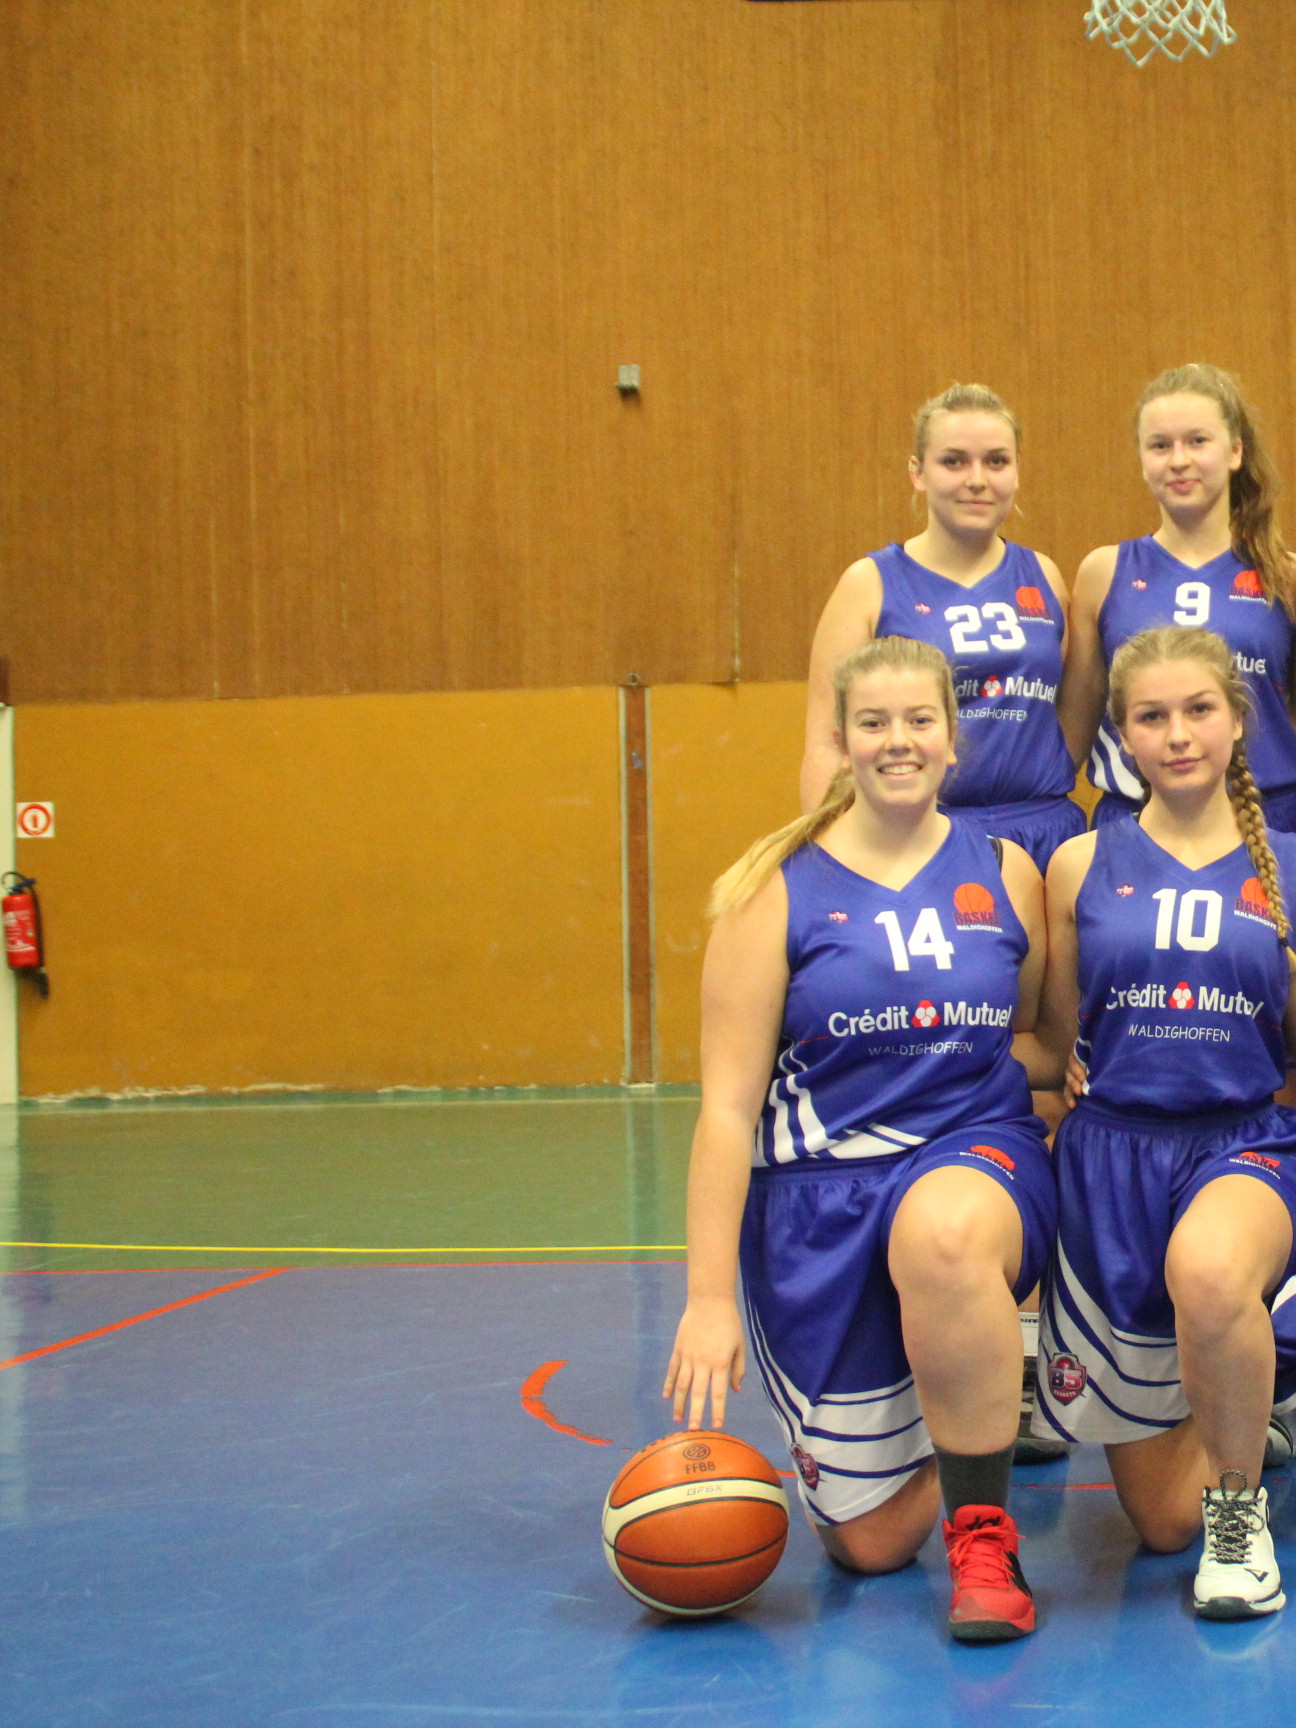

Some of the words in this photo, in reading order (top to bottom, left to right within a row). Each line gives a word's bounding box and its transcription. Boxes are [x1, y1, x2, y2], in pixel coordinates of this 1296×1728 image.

[1173, 581, 1211, 626] 9
[943, 602, 1027, 653] 23
[955, 679, 979, 697] dit
[1004, 676, 1057, 703] Mutuel
[957, 707, 1028, 722] LDIGHOFFEN
[955, 924, 1004, 933] WALDIGHOFFEN
[1152, 888, 1223, 952] 10
[1233, 909, 1278, 931] WALDIGHOFFE
[874, 907, 955, 972] 14
[827, 1004, 910, 1038] Crédit
[943, 1000, 1013, 1029] Mutuel
[1128, 1024, 1230, 1042] WALDIGHOFFEN
[868, 1040, 973, 1056] WALDIGHOFFEN
[684, 1461, 716, 1475] FFBB
